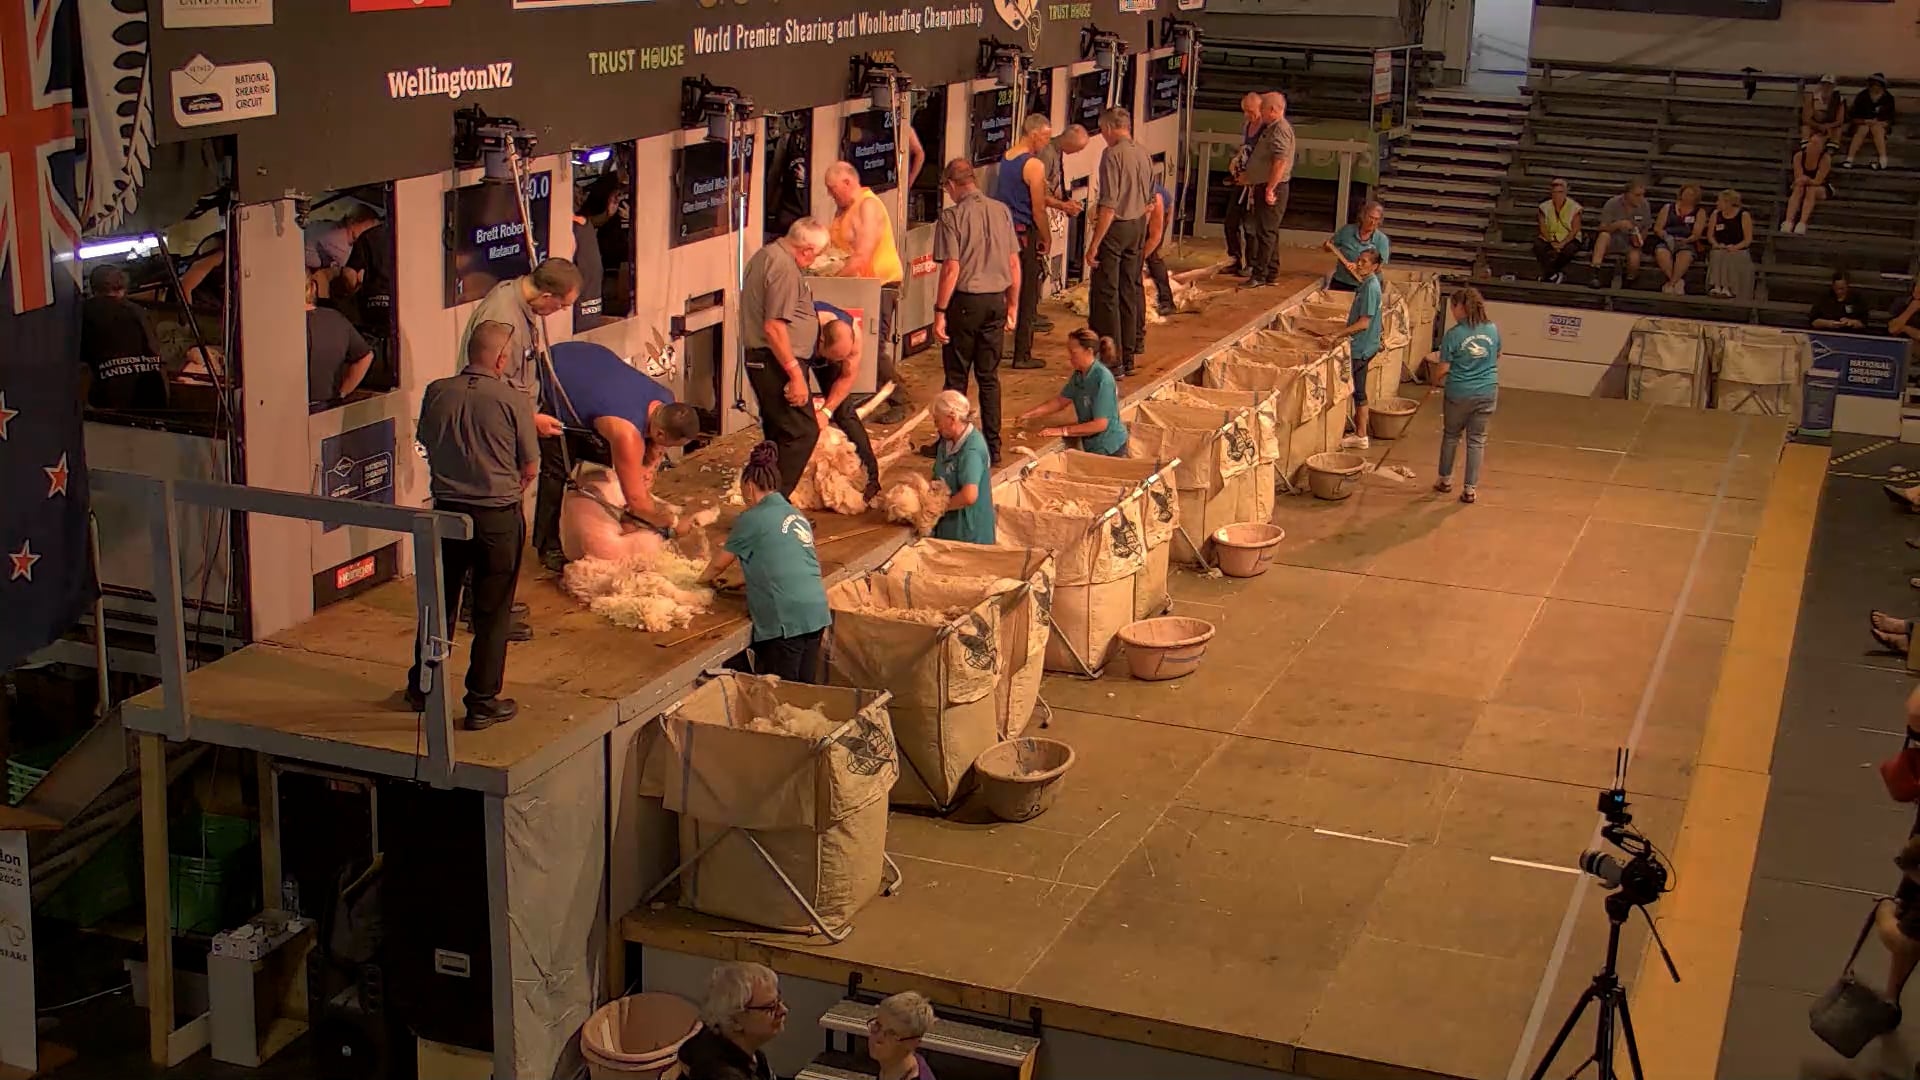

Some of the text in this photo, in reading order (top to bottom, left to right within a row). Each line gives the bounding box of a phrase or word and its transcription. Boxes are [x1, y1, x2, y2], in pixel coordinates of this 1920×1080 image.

[694, 2, 983, 54] World Premier Shearing and Woolhandling Championship
[588, 44, 685, 75] TRUST HOUSE
[235, 72, 269, 84] NATIONAL
[387, 62, 513, 99] WellingtonNZ
[235, 84, 270, 97] SHEARING
[235, 97, 263, 109] CIRCUIT
[476, 225, 499, 244] Brett
[1849, 359, 1890, 370] NATIONAL
[100, 364, 133, 379] LANDS
[1848, 367, 1890, 378] SHEARING
[1847, 375, 1880, 385] CIRCUIT
